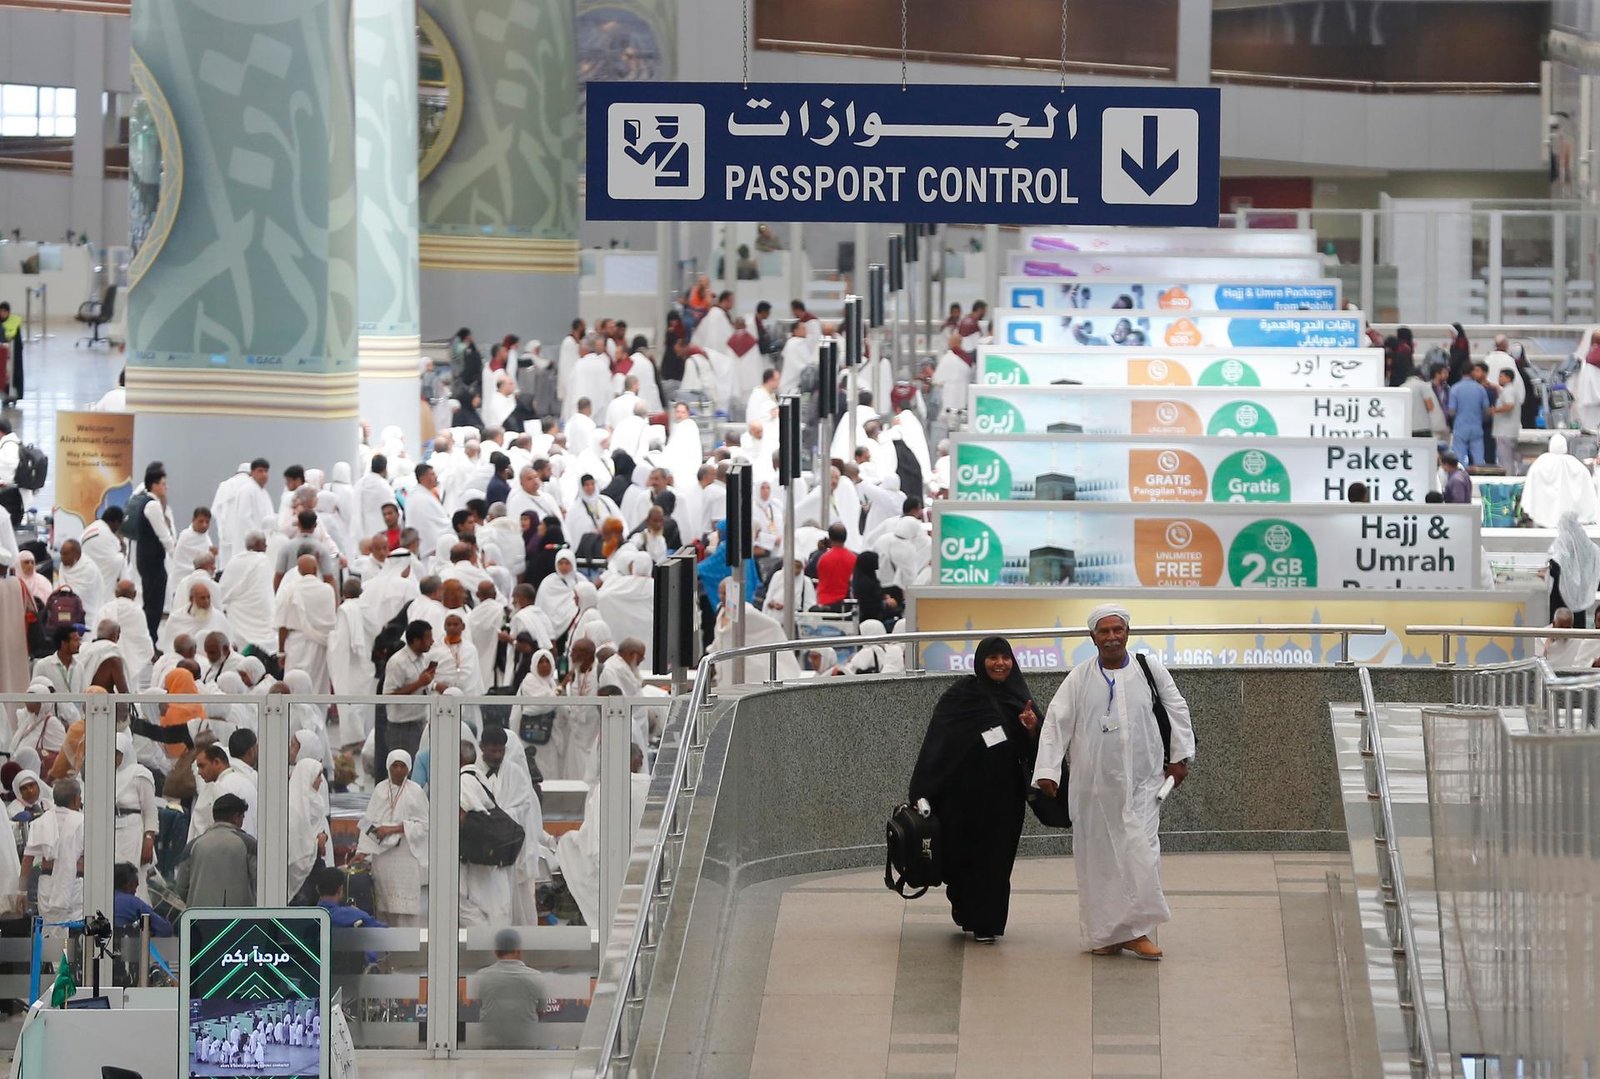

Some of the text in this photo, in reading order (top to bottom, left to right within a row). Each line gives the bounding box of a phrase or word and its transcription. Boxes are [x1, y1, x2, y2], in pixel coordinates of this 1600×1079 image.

[725, 165, 1079, 204] PASSPORT CONTROL
[1222, 287, 1334, 299] Hajj & Umra Packages
[1330, 359, 1363, 379] حج
[1314, 397, 1385, 423] Hajj &
[1327, 446, 1413, 470] Paket
[957, 459, 1000, 486] زين
[1145, 474, 1192, 486] GRATIS
[1133, 486, 1204, 497] Panggilan Tanpa
[1228, 478, 1280, 494] Gratis
[1392, 478, 1414, 502] &
[1361, 515, 1450, 546] Hajj &
[941, 530, 990, 562] زين
[1156, 552, 1202, 560] UNLIMITED
[1356, 547, 1455, 572] Umrah
[1156, 562, 1202, 577] FREE
[1241, 553, 1303, 587] 2 GB
[1267, 577, 1307, 587] FREE
[1017, 649, 1058, 667] this
[1173, 649, 1213, 664] +966
[1219, 649, 1238, 664] 12
[221, 949, 249, 967] بكم
